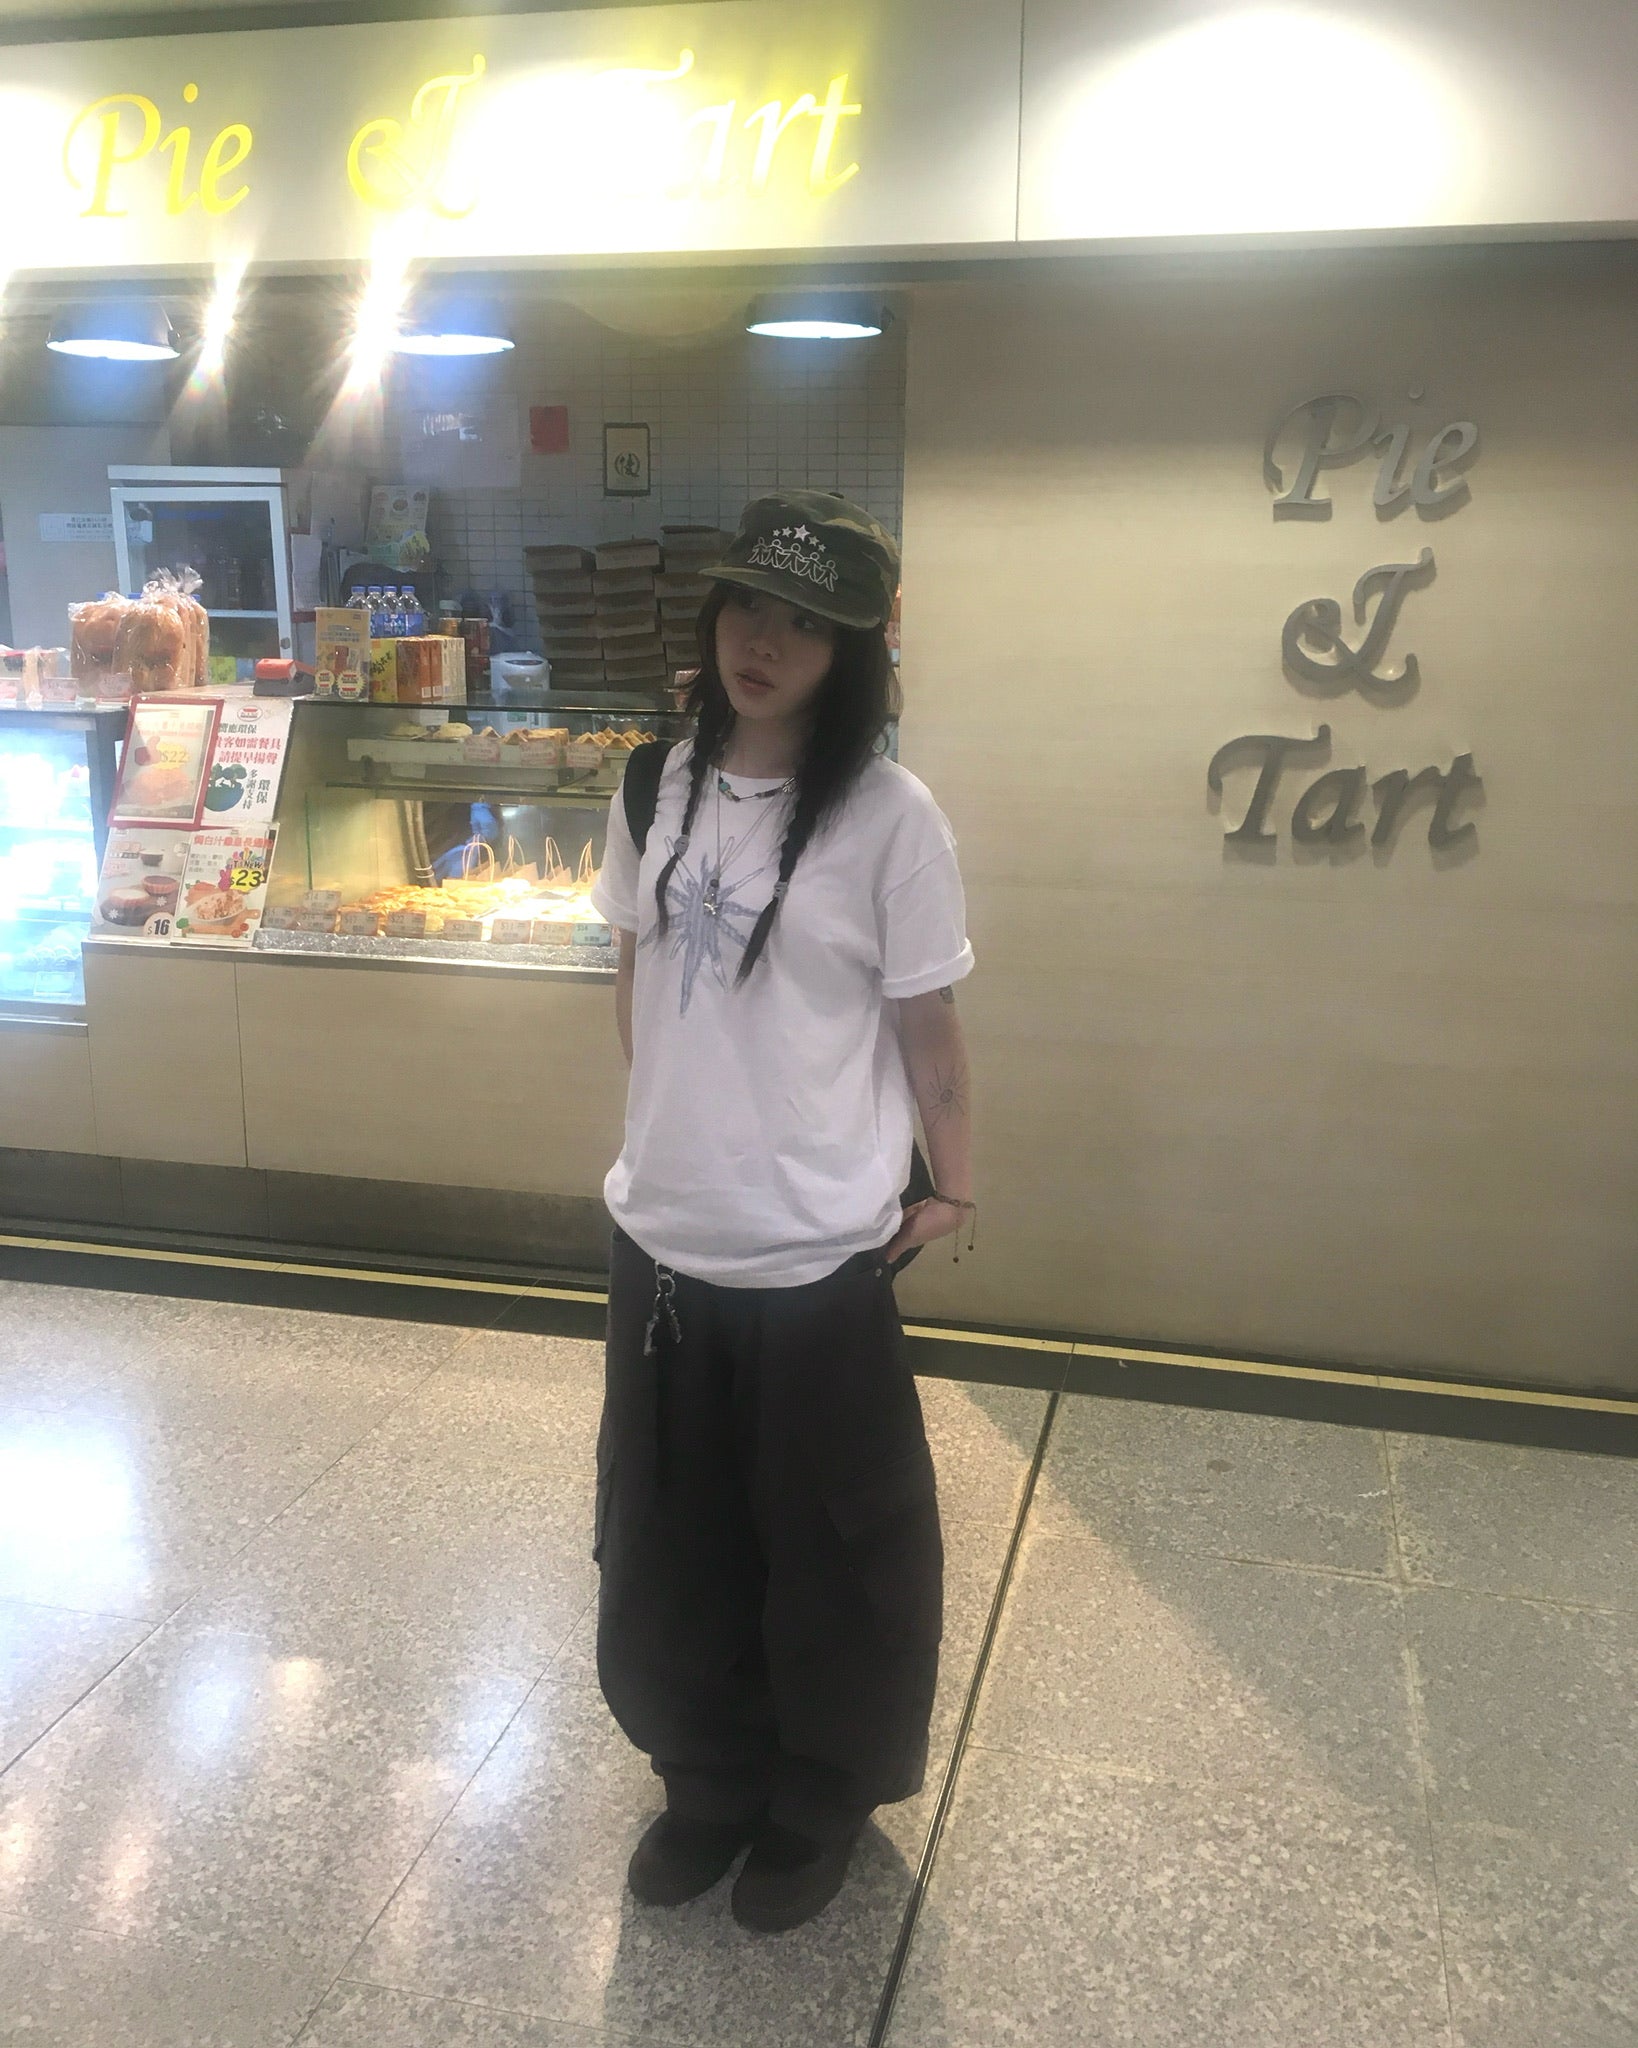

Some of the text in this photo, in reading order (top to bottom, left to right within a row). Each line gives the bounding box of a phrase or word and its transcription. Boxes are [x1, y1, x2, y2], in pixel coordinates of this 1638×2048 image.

[62, 48, 862, 219] Pie & art
[1263, 384, 1478, 512] Pie
[1282, 547, 1435, 690] &
[1207, 723, 1483, 848] Tart
[147, 918, 171, 936] $16
[230, 869, 262, 887] $23
